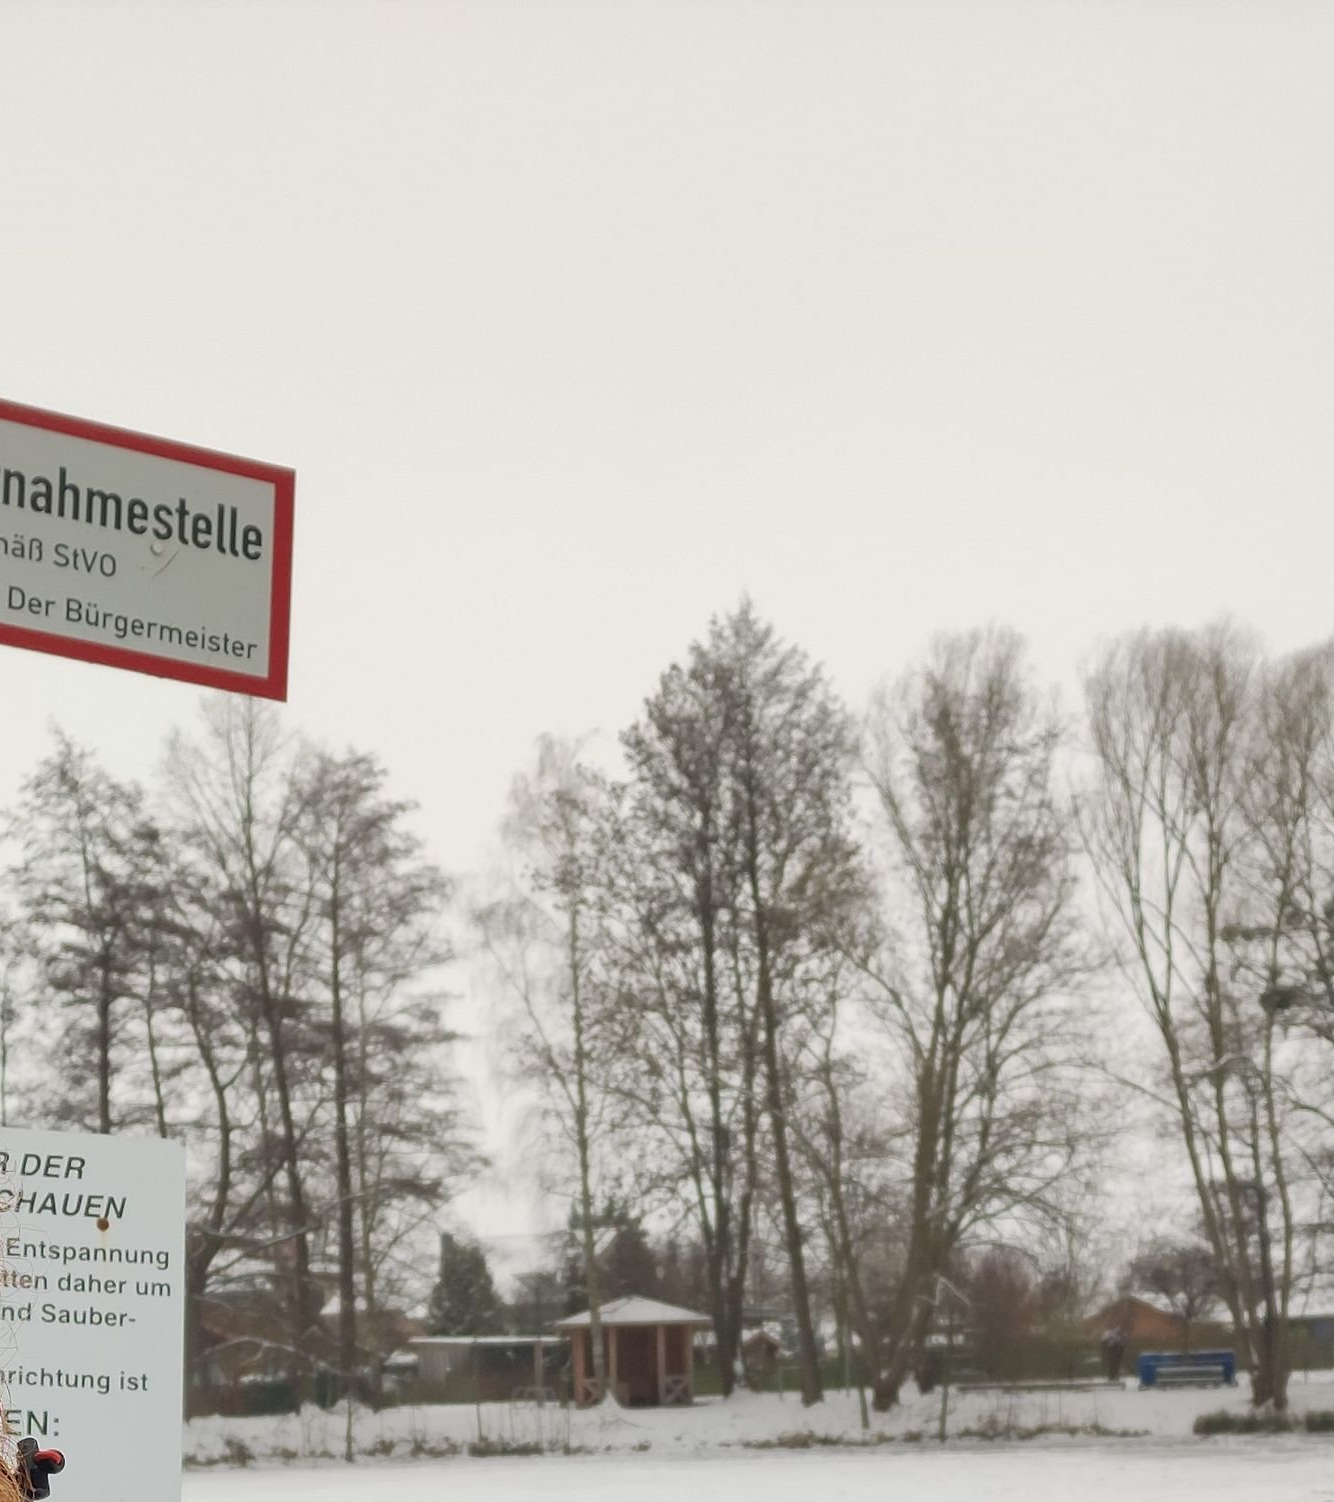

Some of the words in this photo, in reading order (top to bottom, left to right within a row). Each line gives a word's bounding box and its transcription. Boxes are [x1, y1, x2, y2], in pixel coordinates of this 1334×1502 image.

[52, 543, 117, 579] StVO
[7, 585, 56, 617] Der
[65, 598, 258, 660] Bürgermeister
[20, 1153, 86, 1179] DER
[6, 1237, 170, 1270] Entspannung
[1, 1269, 48, 1290] tten
[57, 1272, 127, 1294] daher
[135, 1281, 171, 1297] um
[41, 1303, 137, 1327] Sauber-
[119, 1371, 148, 1392] ist
[4, 1409, 60, 1437] EN:
